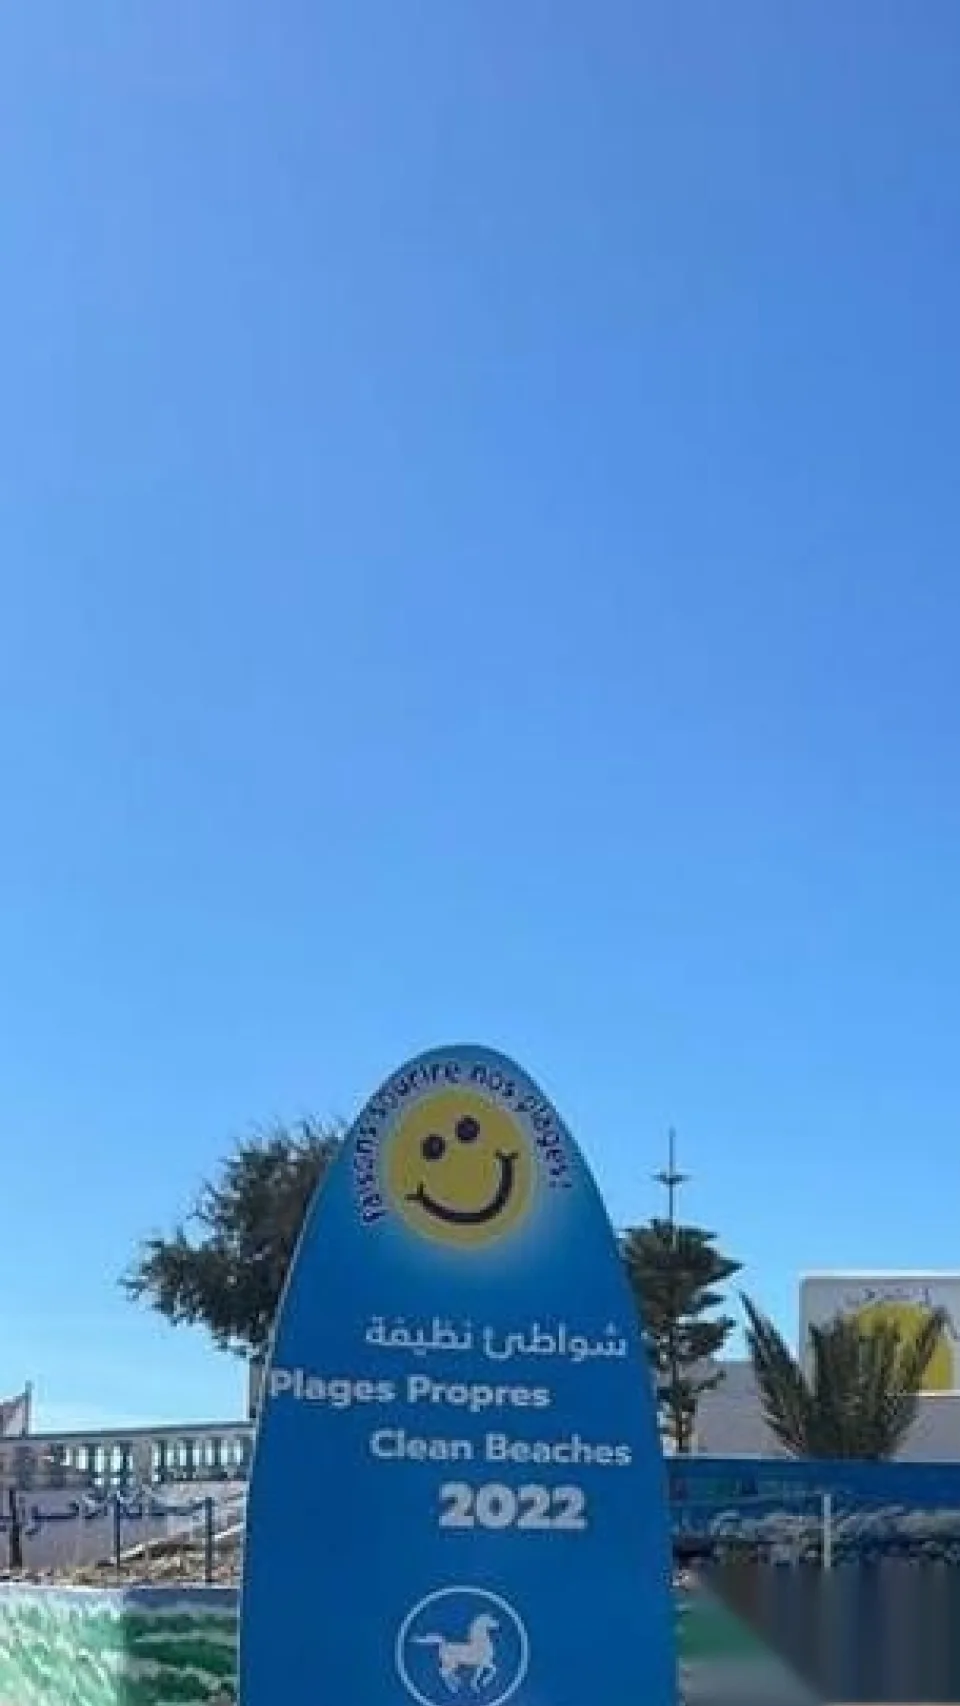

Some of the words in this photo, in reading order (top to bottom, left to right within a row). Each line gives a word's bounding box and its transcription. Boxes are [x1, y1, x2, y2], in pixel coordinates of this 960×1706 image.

[368, 1060, 461, 1120] sourire
[469, 1062, 517, 1098] nos
[365, 1315, 473, 1356] نظيفة
[483, 1321, 628, 1362] شواطئ
[269, 1368, 397, 1408] Plages
[406, 1374, 552, 1412] Propres
[369, 1428, 474, 1460] Clean
[484, 1433, 633, 1466] Beaches
[438, 1481, 588, 1529] 2022
